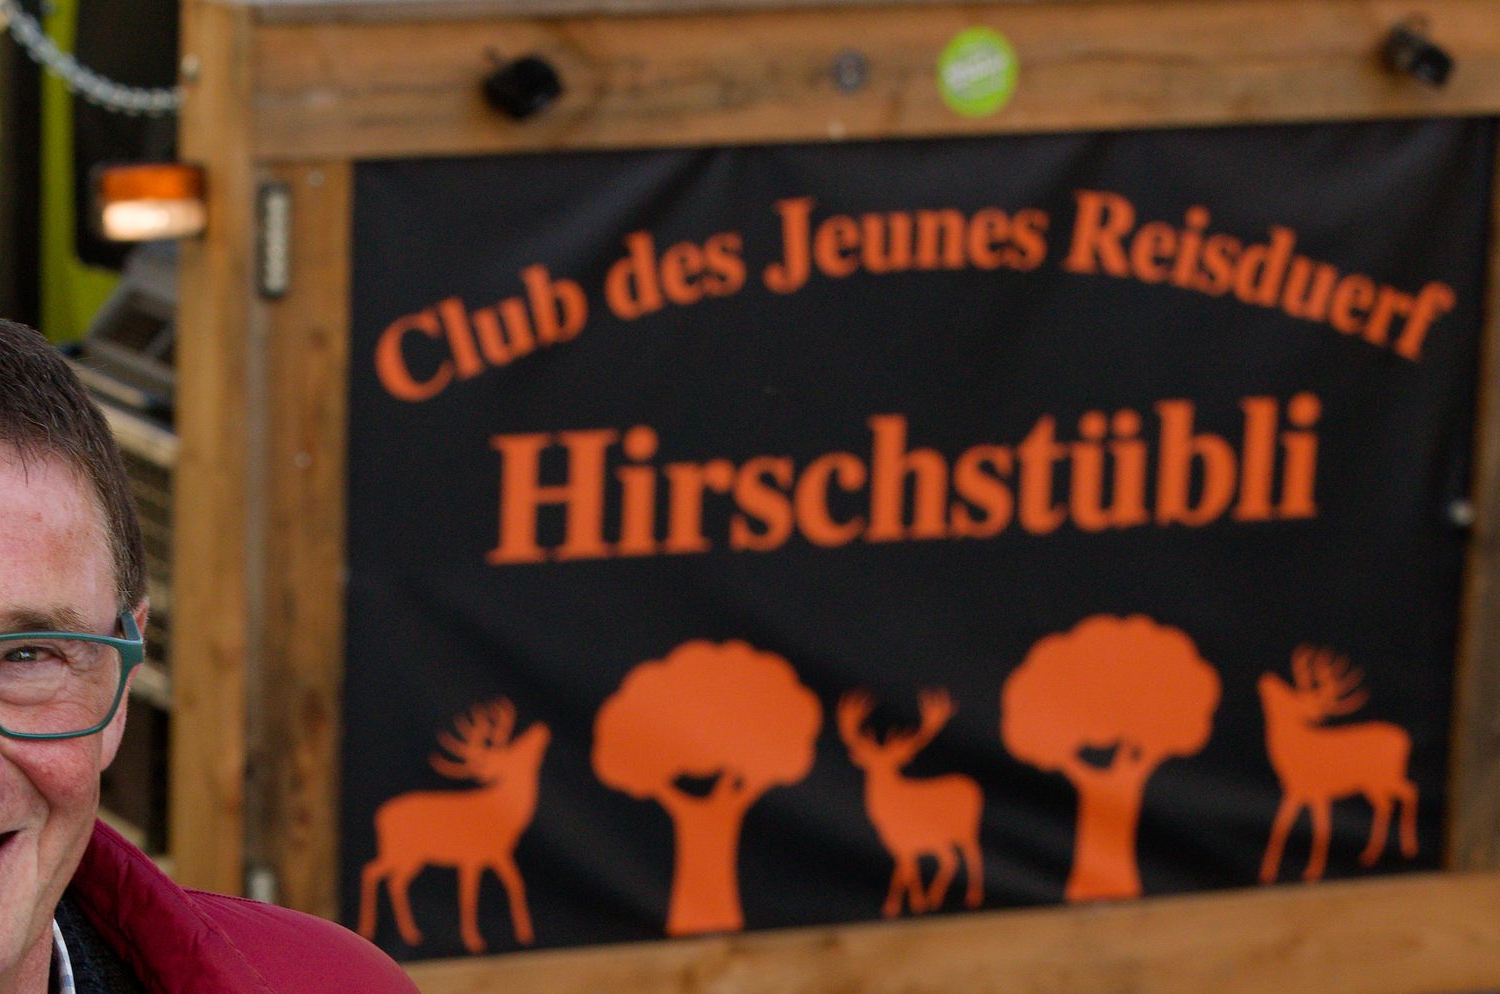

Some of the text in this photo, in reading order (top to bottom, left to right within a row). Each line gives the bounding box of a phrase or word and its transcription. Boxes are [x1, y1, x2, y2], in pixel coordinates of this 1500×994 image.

[376, 192, 1454, 400] Club des Jeunes Reisduerf
[489, 394, 1320, 564] Hirschstübli
